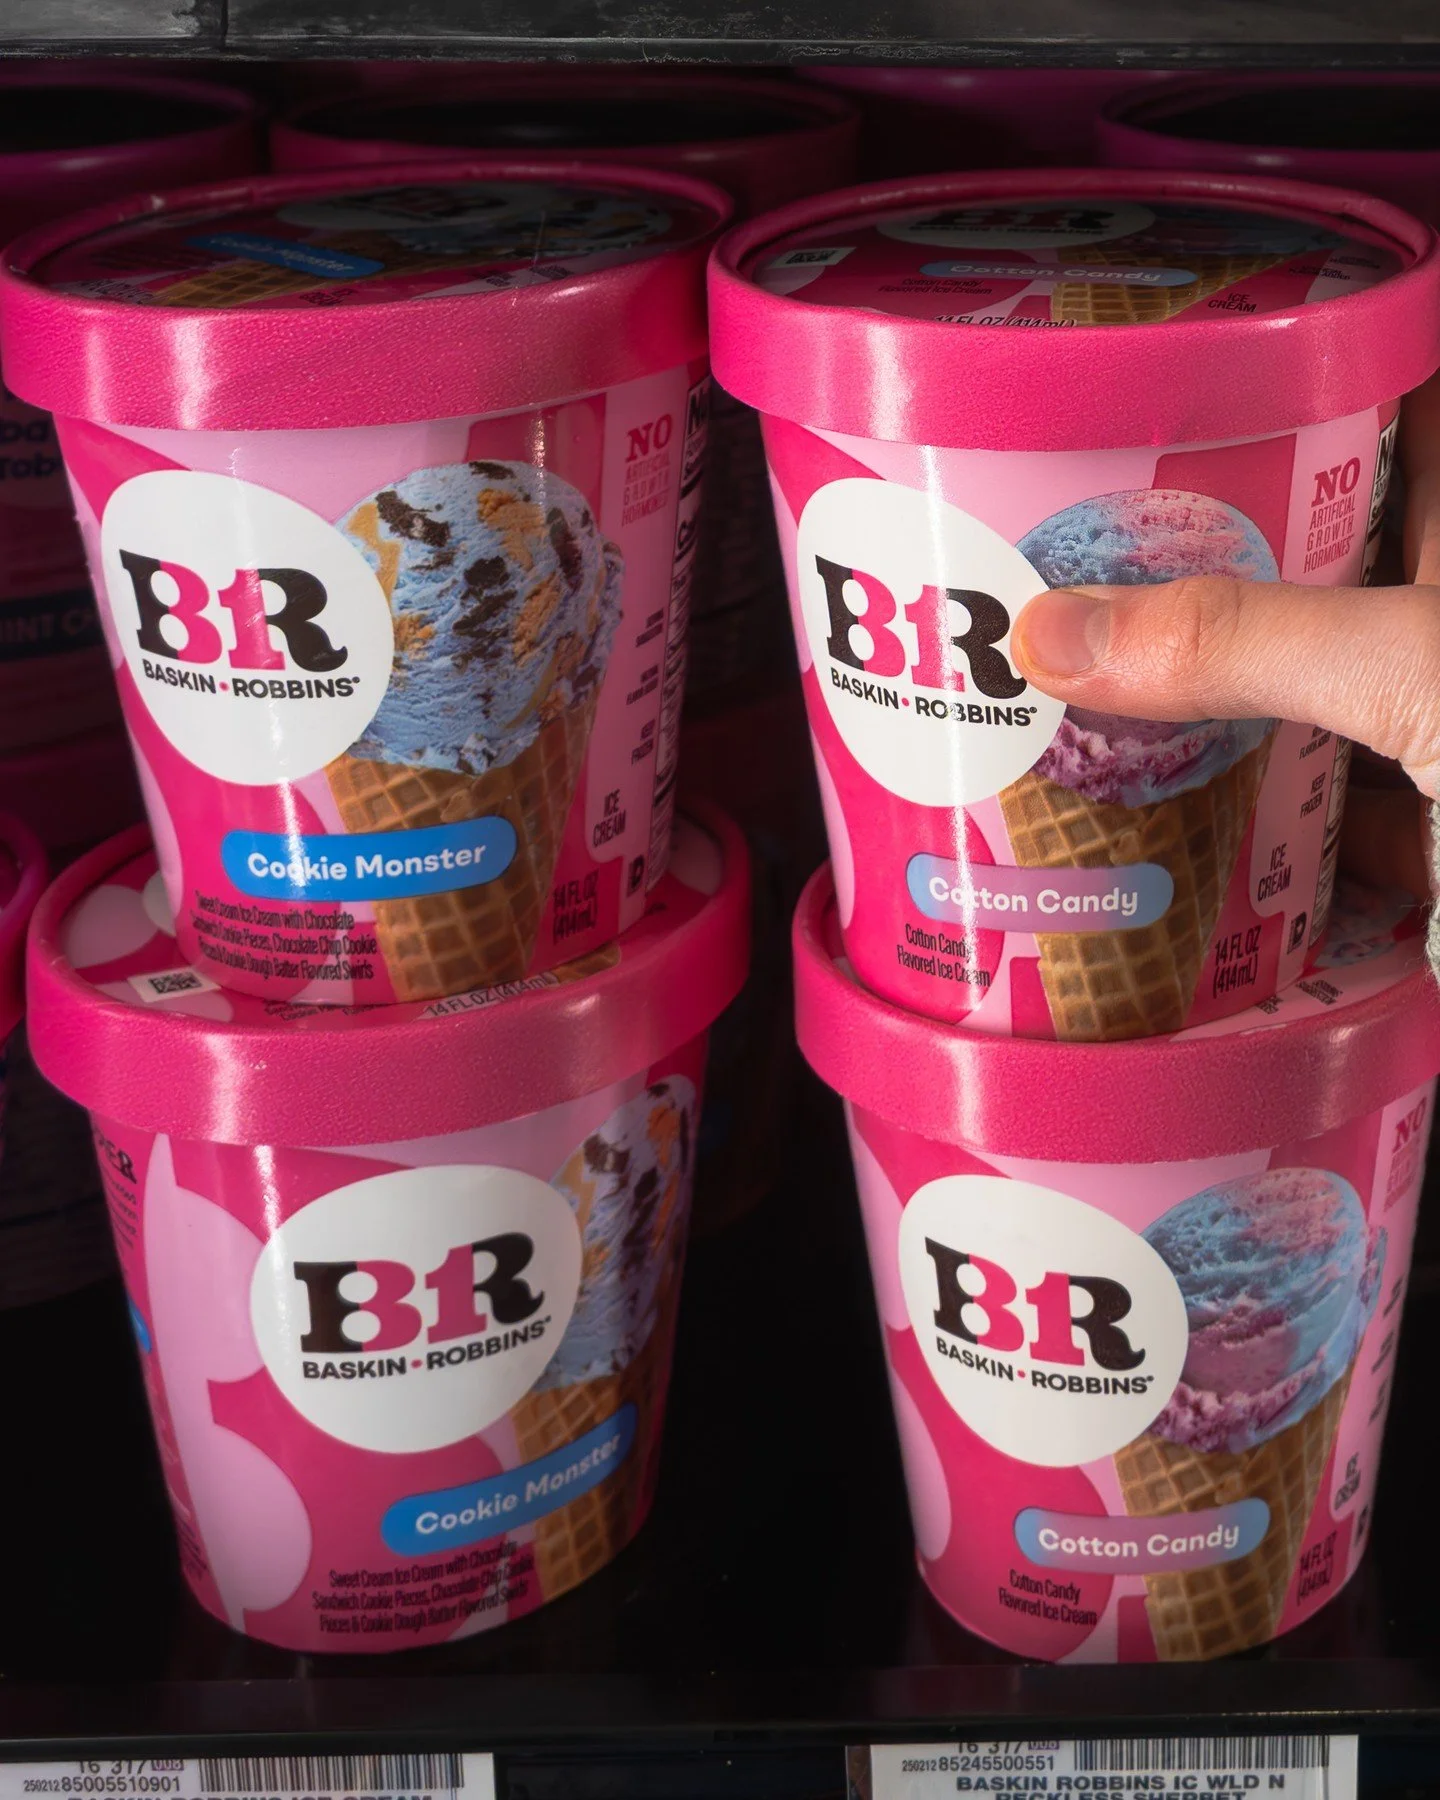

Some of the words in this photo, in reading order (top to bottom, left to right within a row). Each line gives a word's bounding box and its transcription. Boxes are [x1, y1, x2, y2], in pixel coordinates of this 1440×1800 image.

[950, 264, 1058, 277] Cotton
[1063, 268, 1162, 282] Candy
[1208, 300, 1257, 313] CREAM
[1228, 293, 1250, 304] ICE
[625, 413, 672, 464] NO
[1311, 456, 1361, 508] NO
[1309, 493, 1356, 530] ARTIFICIAL
[1306, 515, 1354, 552] GROWTH
[1303, 534, 1355, 574] HORMONES
[142, 658, 217, 694] BASKIN
[830, 666, 900, 710] BASKIN
[604, 788, 621, 818] ICE
[593, 812, 627, 848] CREAM
[247, 852, 347, 882] Cookie
[355, 845, 487, 880] Monster
[1269, 842, 1288, 873] ICE
[567, 880, 582, 907] FL
[583, 868, 600, 901] OZ
[928, 876, 1028, 913] Cotton
[1036, 887, 1138, 917] Candy
[1257, 864, 1292, 902] CREAM
[195, 889, 219, 914] weet
[252, 906, 281, 929] Cream
[282, 908, 303, 930] with
[304, 910, 355, 930] Chocolate
[272, 933, 319, 955] Chocolate
[319, 935, 342, 961] Chip
[342, 934, 377, 955] Cookie
[905, 923, 938, 952] Cotton
[938, 934, 974, 963] Candy
[1215, 936, 1228, 966] 14
[1229, 932, 1244, 962] FL
[1245, 924, 1262, 955] OZ
[273, 958, 300, 979] Batter
[300, 957, 341, 980] Flavored
[342, 960, 374, 980] Swirls
[897, 944, 936, 975] Flavored
[937, 955, 954, 980] Ice
[954, 963, 991, 988] Cream
[1213, 953, 1258, 999] (414mL)
[427, 1003, 449, 1016] 14
[449, 997, 473, 1012] FL
[470, 989, 498, 1005] OZ
[1392, 1096, 1427, 1154] NO
[302, 1357, 407, 1380] BASKIN
[936, 1335, 1014, 1382] BASKIN
[415, 1493, 519, 1535] Cookie
[524, 1434, 621, 1504] Monster
[1038, 1527, 1139, 1558] Cotton
[1146, 1524, 1240, 1556] Candy
[329, 1569, 360, 1589] Sweet
[361, 1568, 394, 1587] Cream
[395, 1566, 410, 1585] Ice
[411, 1562, 443, 1582] Cream
[445, 1554, 469, 1575] with
[1009, 1568, 1044, 1596] Cotton
[1045, 1577, 1081, 1605] Candy
[998, 1587, 1042, 1618] Flavored
[1042, 1600, 1060, 1621] Ice
[1060, 1604, 1098, 1627] Cream
[957, 1776, 1047, 1791] BASKIN
[1056, 1775, 1165, 1791] ROBBINS
[1174, 1775, 1198, 1790] IC
[1206, 1774, 1260, 1790] WLD
[1268, 1774, 1285, 1789] N
